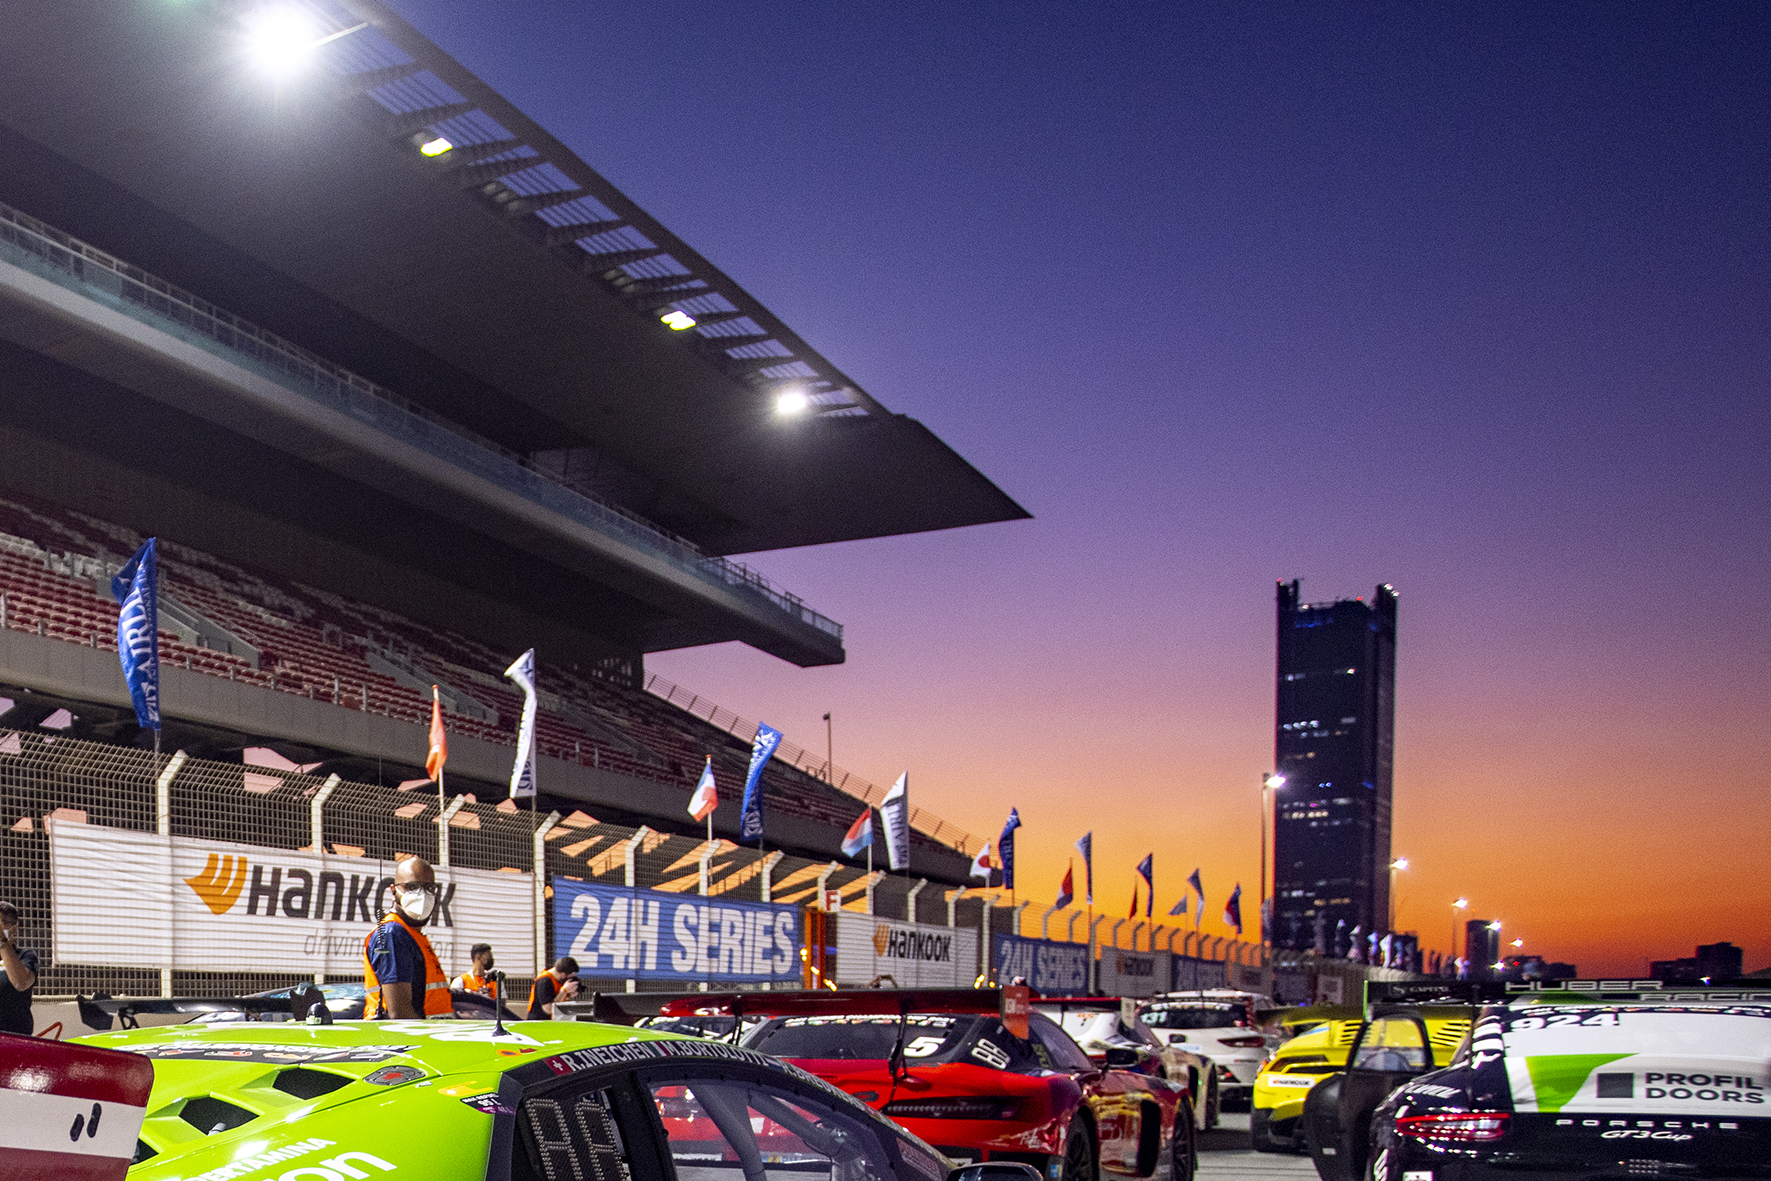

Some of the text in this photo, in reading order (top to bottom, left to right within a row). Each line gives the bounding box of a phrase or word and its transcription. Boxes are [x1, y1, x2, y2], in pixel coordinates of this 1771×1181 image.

[568, 893, 795, 974] 24H SERIES
[1505, 980, 1664, 991] HUBER
[1511, 1013, 1619, 1031] 924
[902, 1036, 946, 1057] 5
[1645, 1072, 1765, 1090] PROFIL
[1645, 1087, 1765, 1105] DOORS
[1555, 1118, 1740, 1130] PORSCHE
